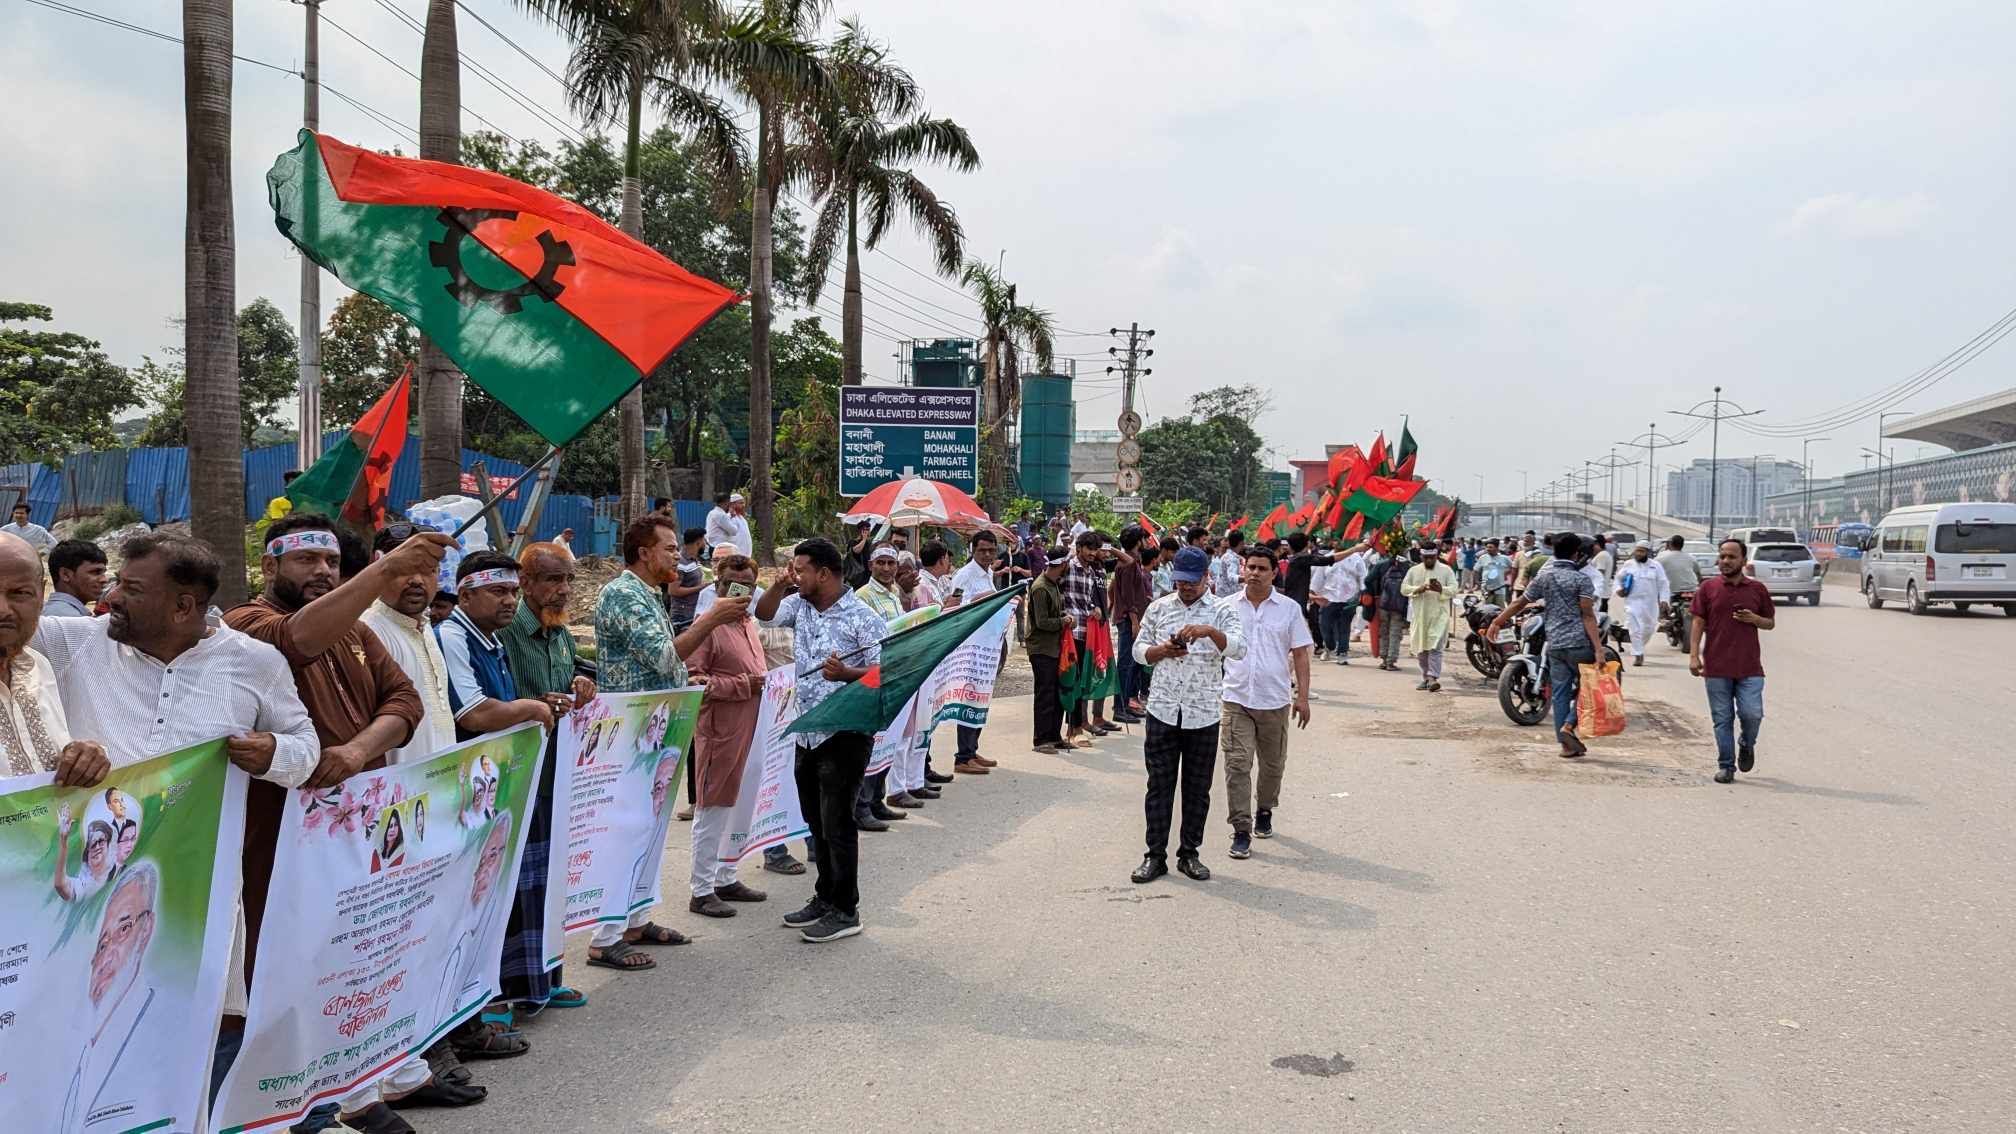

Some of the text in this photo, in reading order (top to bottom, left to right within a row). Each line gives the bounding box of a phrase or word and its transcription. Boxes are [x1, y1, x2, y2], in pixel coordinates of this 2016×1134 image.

[846, 391, 972, 406] ঢাকা এলিভেটেড এক্সপ্রেসওয়ে
[846, 408, 972, 420] DHAKA ELEVATED EXPRESSWAY
[845, 428, 874, 441] বনানী
[924, 431, 956, 441] BANANI
[845, 441, 885, 453] মহাখালী
[924, 444, 973, 454] MOHAKHALI
[845, 454, 884, 466] ফার্মগেট
[923, 457, 968, 466] FARMGATE
[845, 467, 893, 479] হাতিরঝিল
[923, 469, 973, 479] HATIRJHEEL
